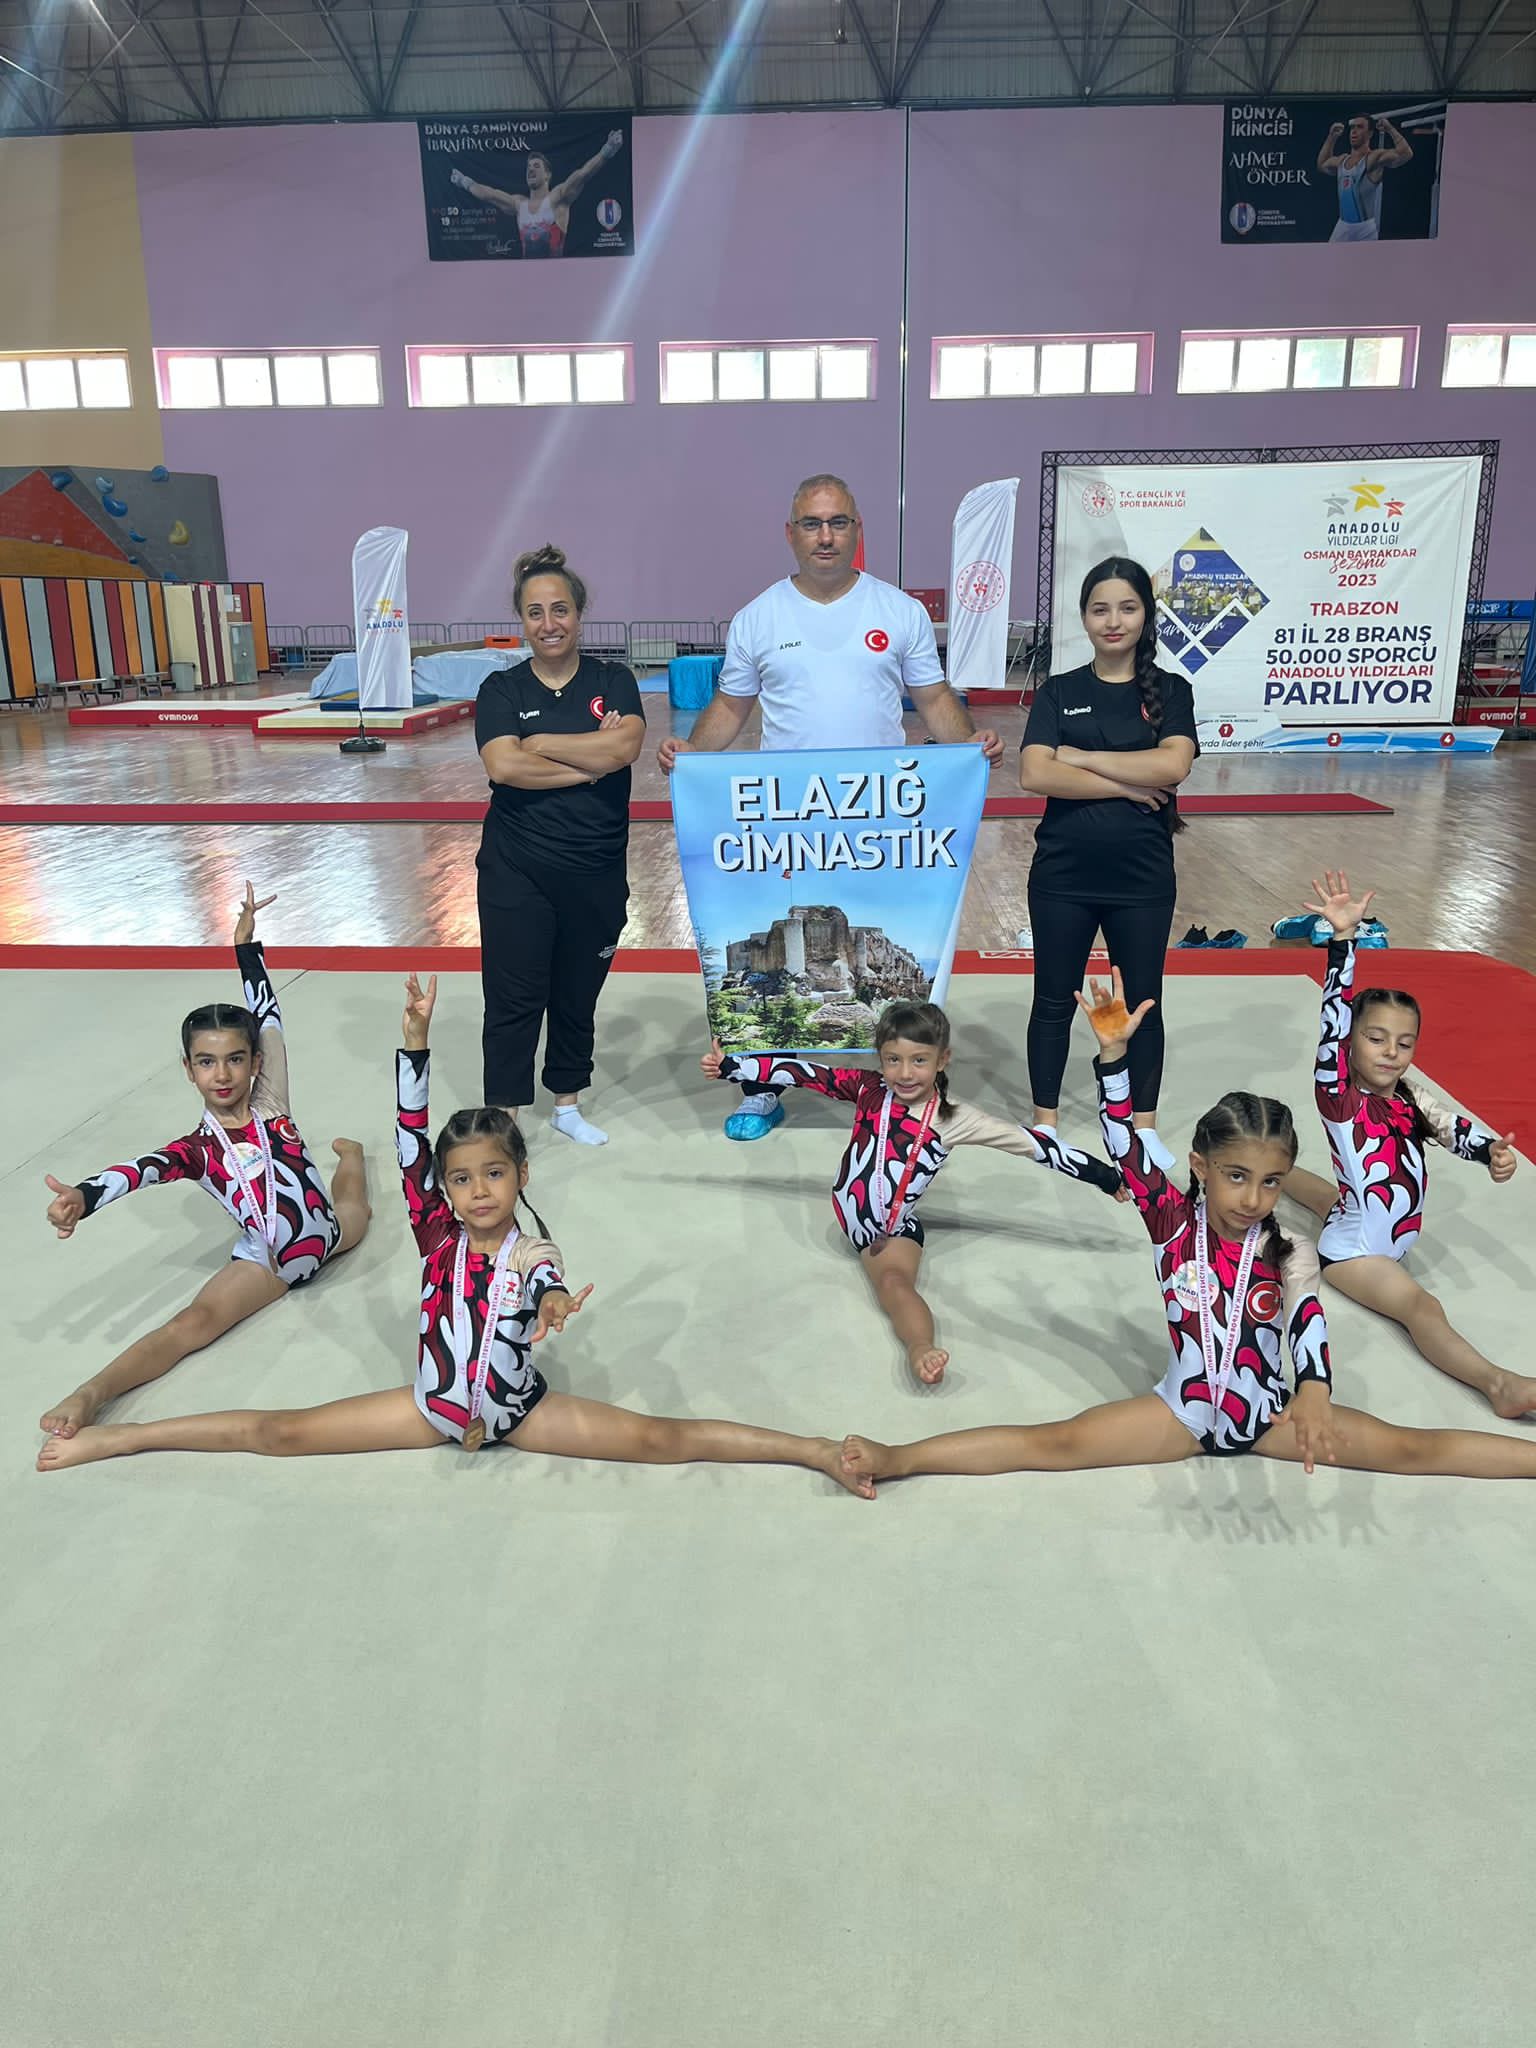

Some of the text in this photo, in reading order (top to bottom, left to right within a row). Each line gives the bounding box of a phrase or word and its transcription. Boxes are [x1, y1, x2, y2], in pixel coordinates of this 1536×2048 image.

[1231, 104, 1288, 120] DÜNYA
[425, 121, 547, 136] DÜNYA ŞAMPİYONU
[1231, 120, 1293, 137] İKİNCİSİ
[1229, 151, 1287, 169] AHMET
[1247, 168, 1311, 186] ÖNDER
[1119, 490, 1186, 499] T.C. GENÇLİK VE
[1120, 499, 1186, 508] SPOR BAKANLIĞI
[1328, 522, 1400, 534] ANADOLU
[1328, 535, 1378, 546] YILDIZLAR
[1303, 549, 1417, 560] OSMAN BAYRAKDAR
[1337, 574, 1377, 587] 2023
[1310, 601, 1399, 616] TRABZON
[1274, 623, 1432, 645] 81 İL 28 BRANŞ
[1266, 646, 1437, 665] 50.000 SPORCU
[1268, 665, 1433, 679] ANADOLU YILDIZLARI
[1264, 680, 1433, 705] PARLIYOR
[1480, 711, 1526, 720] GYMNOA
[1222, 739, 1242, 747] lider
[1243, 739, 1265, 748] şehir
[730, 758, 926, 822] ELAZIĞ
[712, 819, 958, 873] CİMNASTİK
